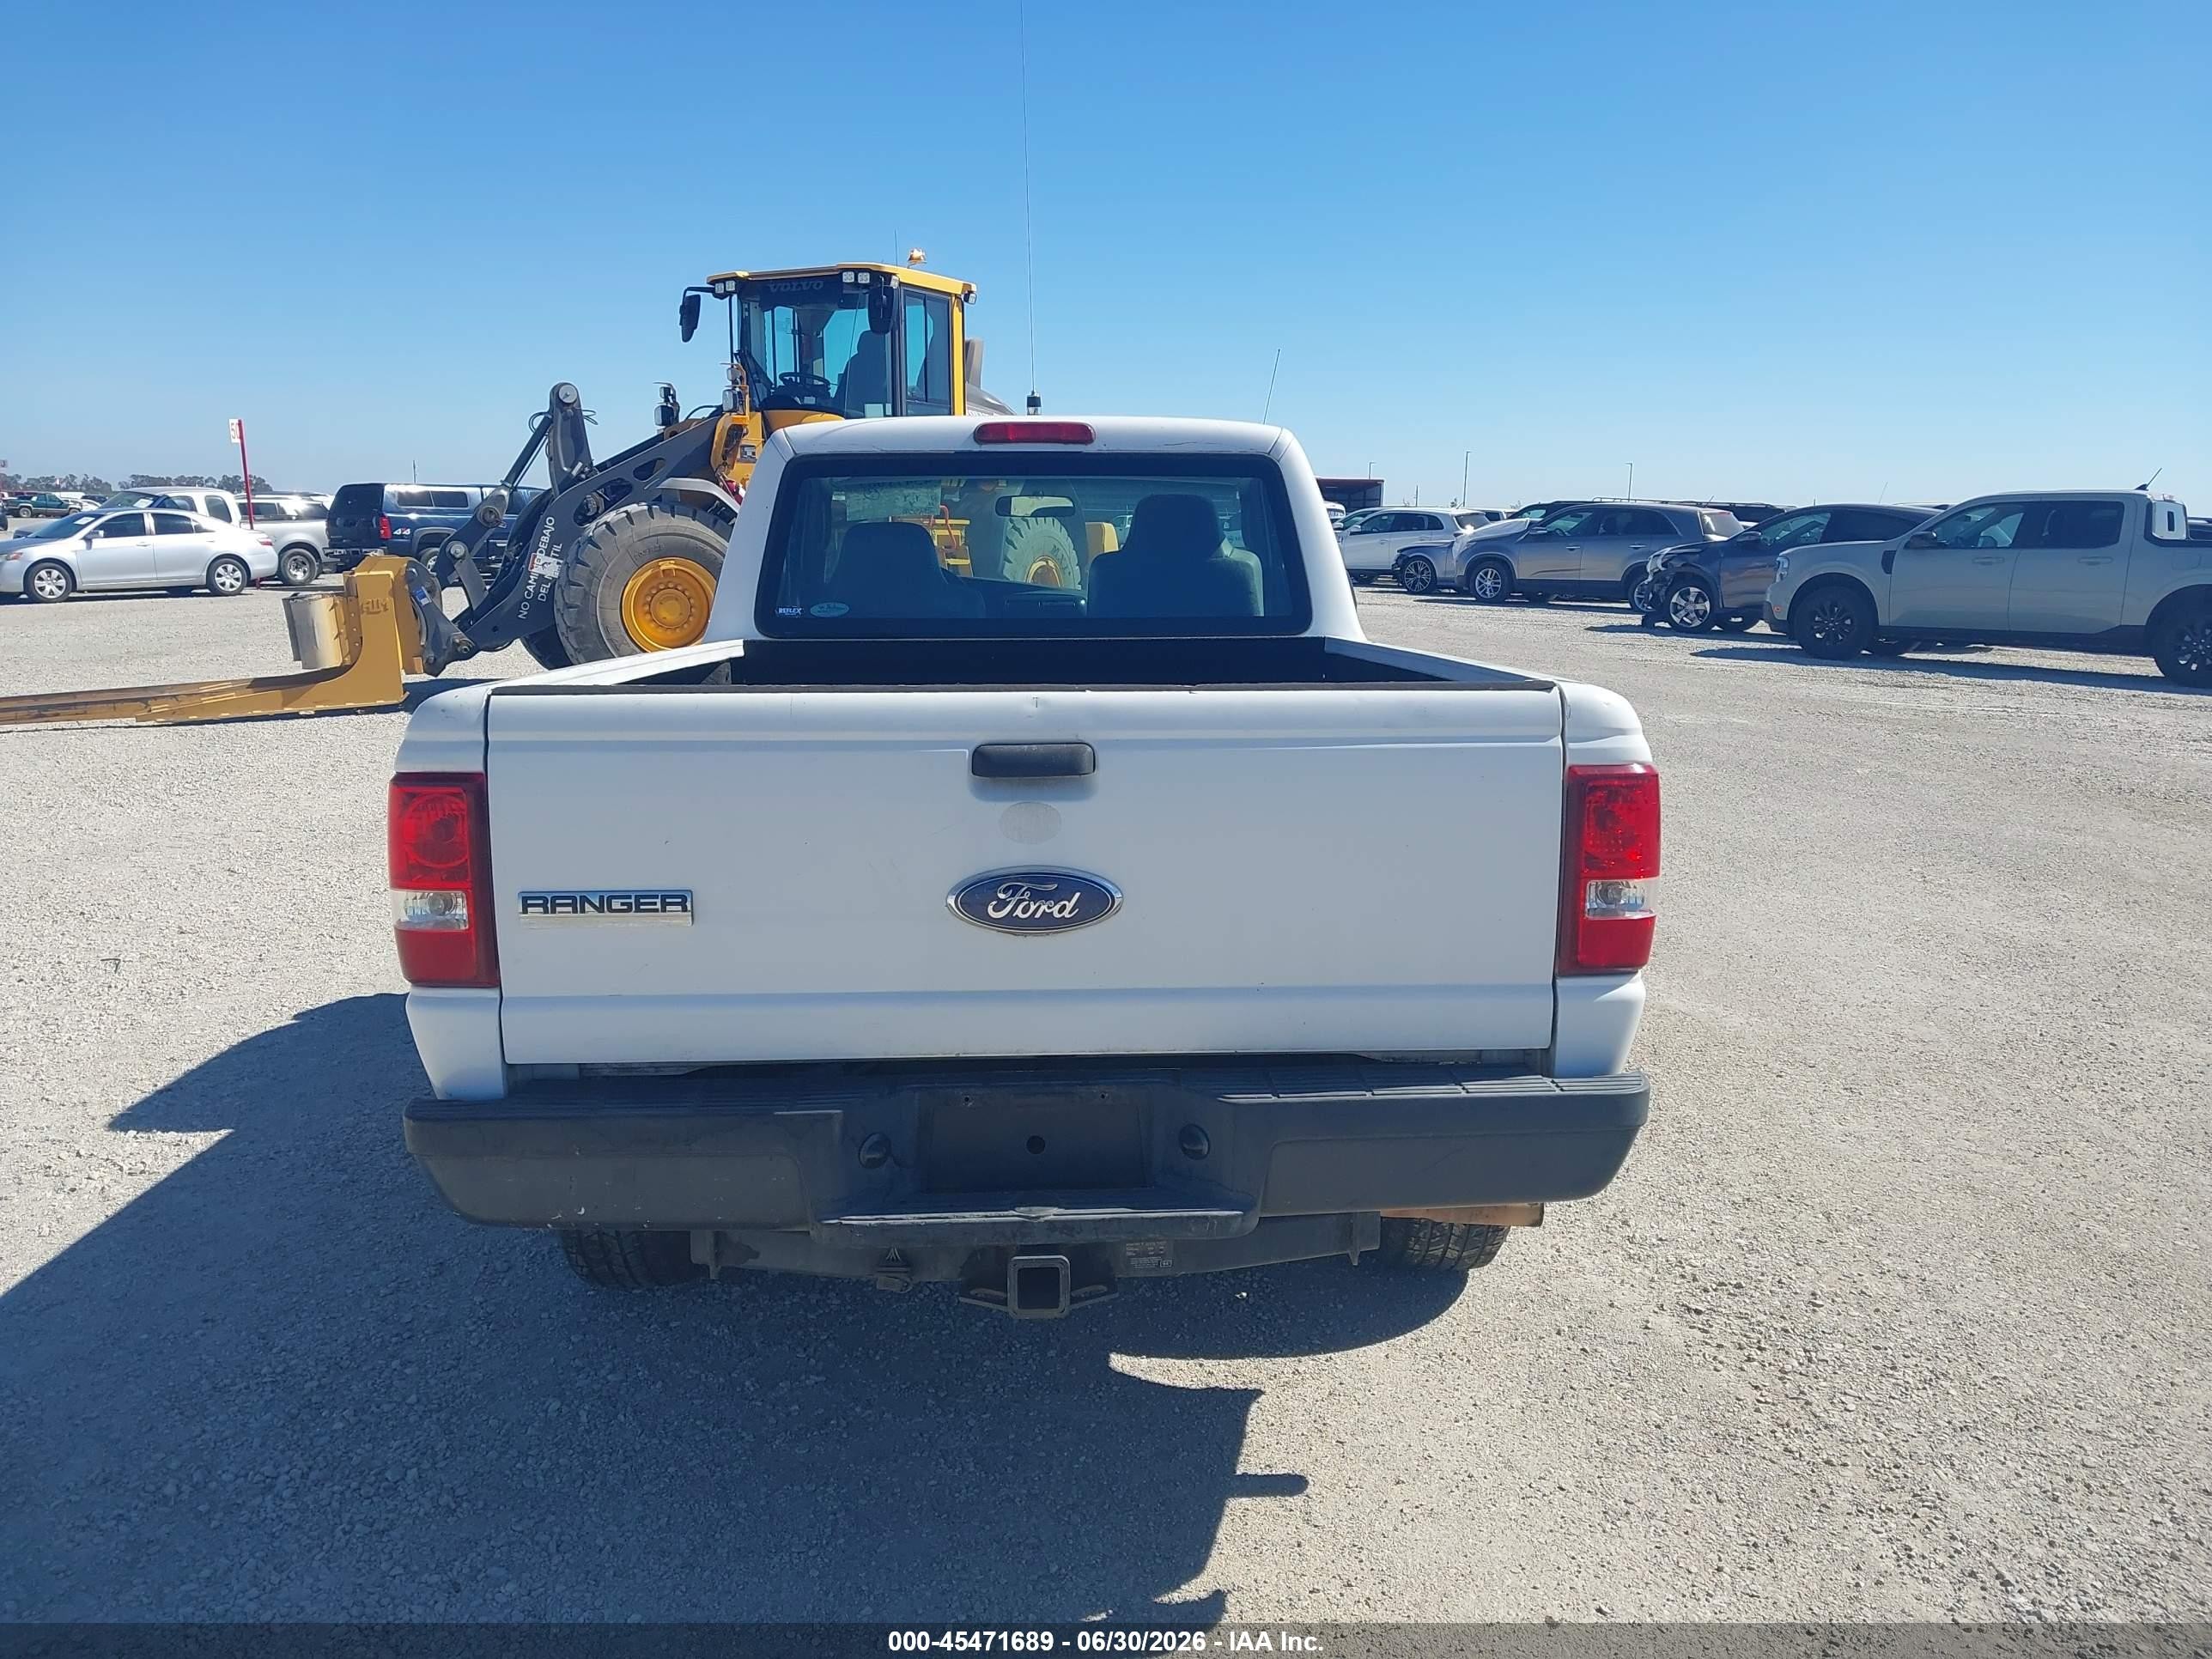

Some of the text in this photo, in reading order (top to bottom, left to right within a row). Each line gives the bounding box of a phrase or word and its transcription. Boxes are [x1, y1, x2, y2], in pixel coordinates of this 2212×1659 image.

[769, 281, 824, 292] VOLVO
[518, 602, 530, 619] NO
[537, 516, 555, 556] DEBAJO
[538, 582, 550, 602] DEL
[521, 894, 690, 915] RANGER
[988, 882, 1081, 919] Ford
